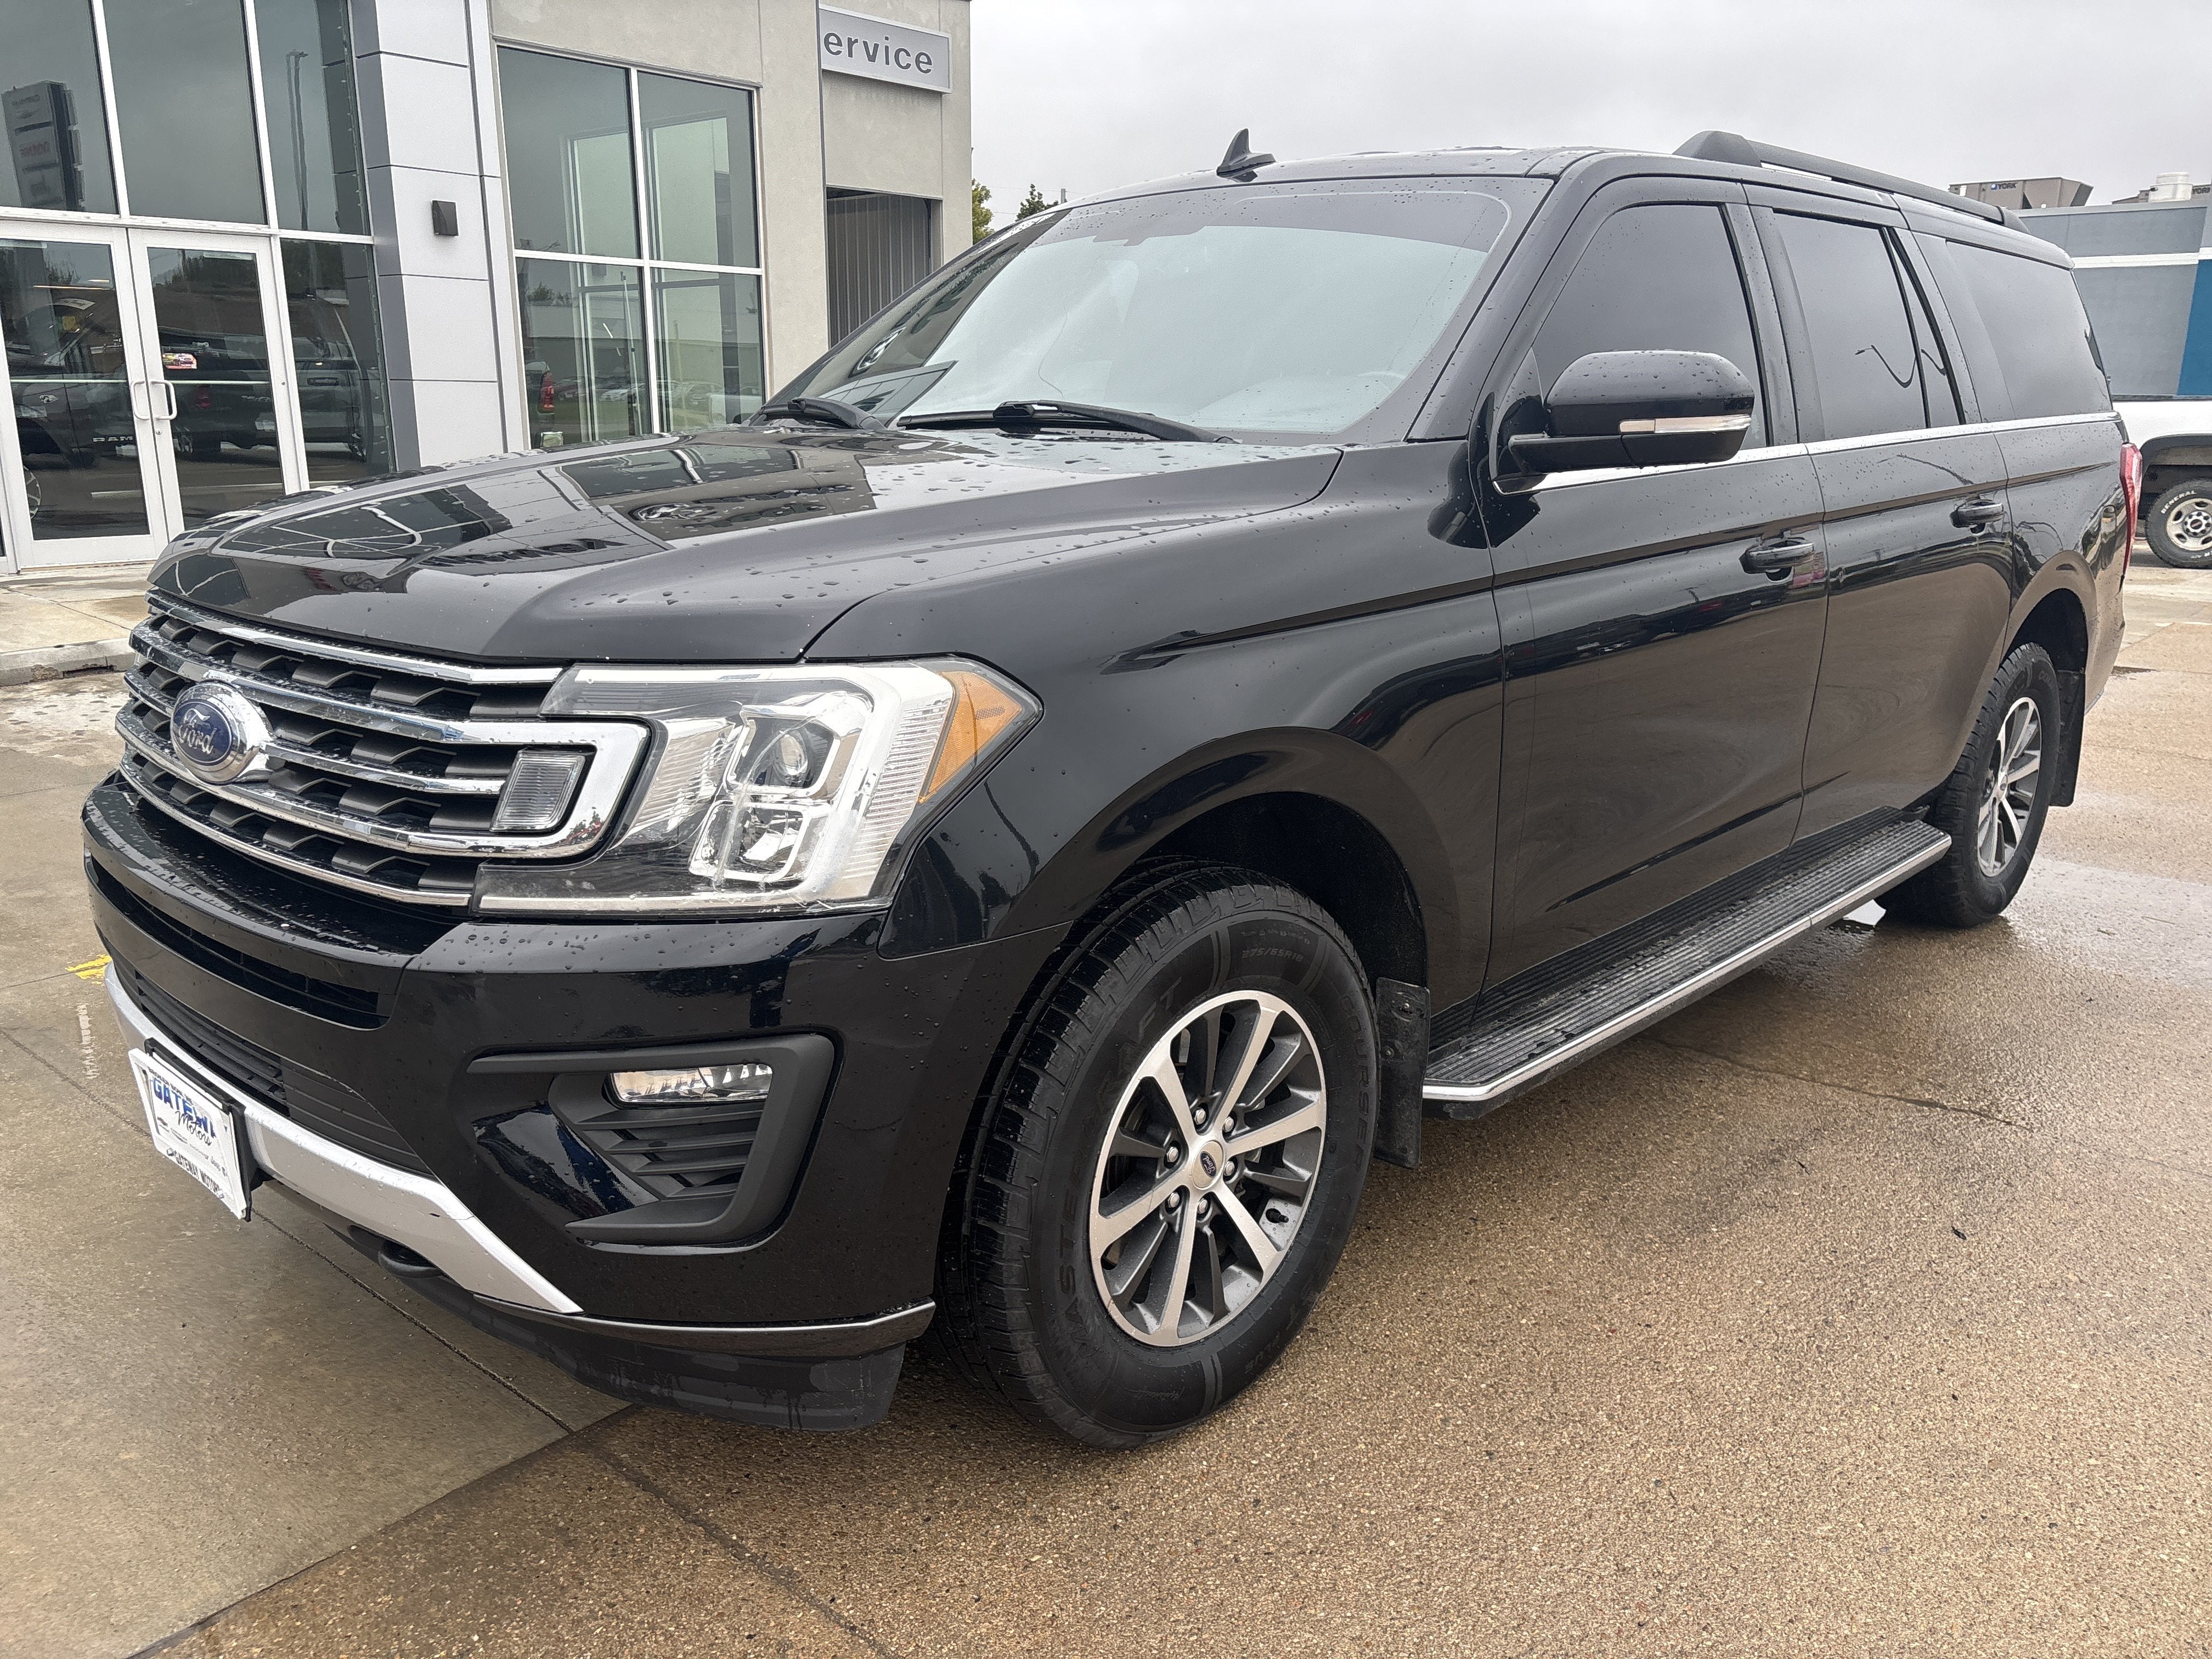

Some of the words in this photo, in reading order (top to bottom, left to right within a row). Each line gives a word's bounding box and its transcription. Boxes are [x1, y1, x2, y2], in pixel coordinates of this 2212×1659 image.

[824, 32, 933, 74] ervice
[178, 708, 218, 755] Ford
[175, 1110, 212, 1146] Motors
